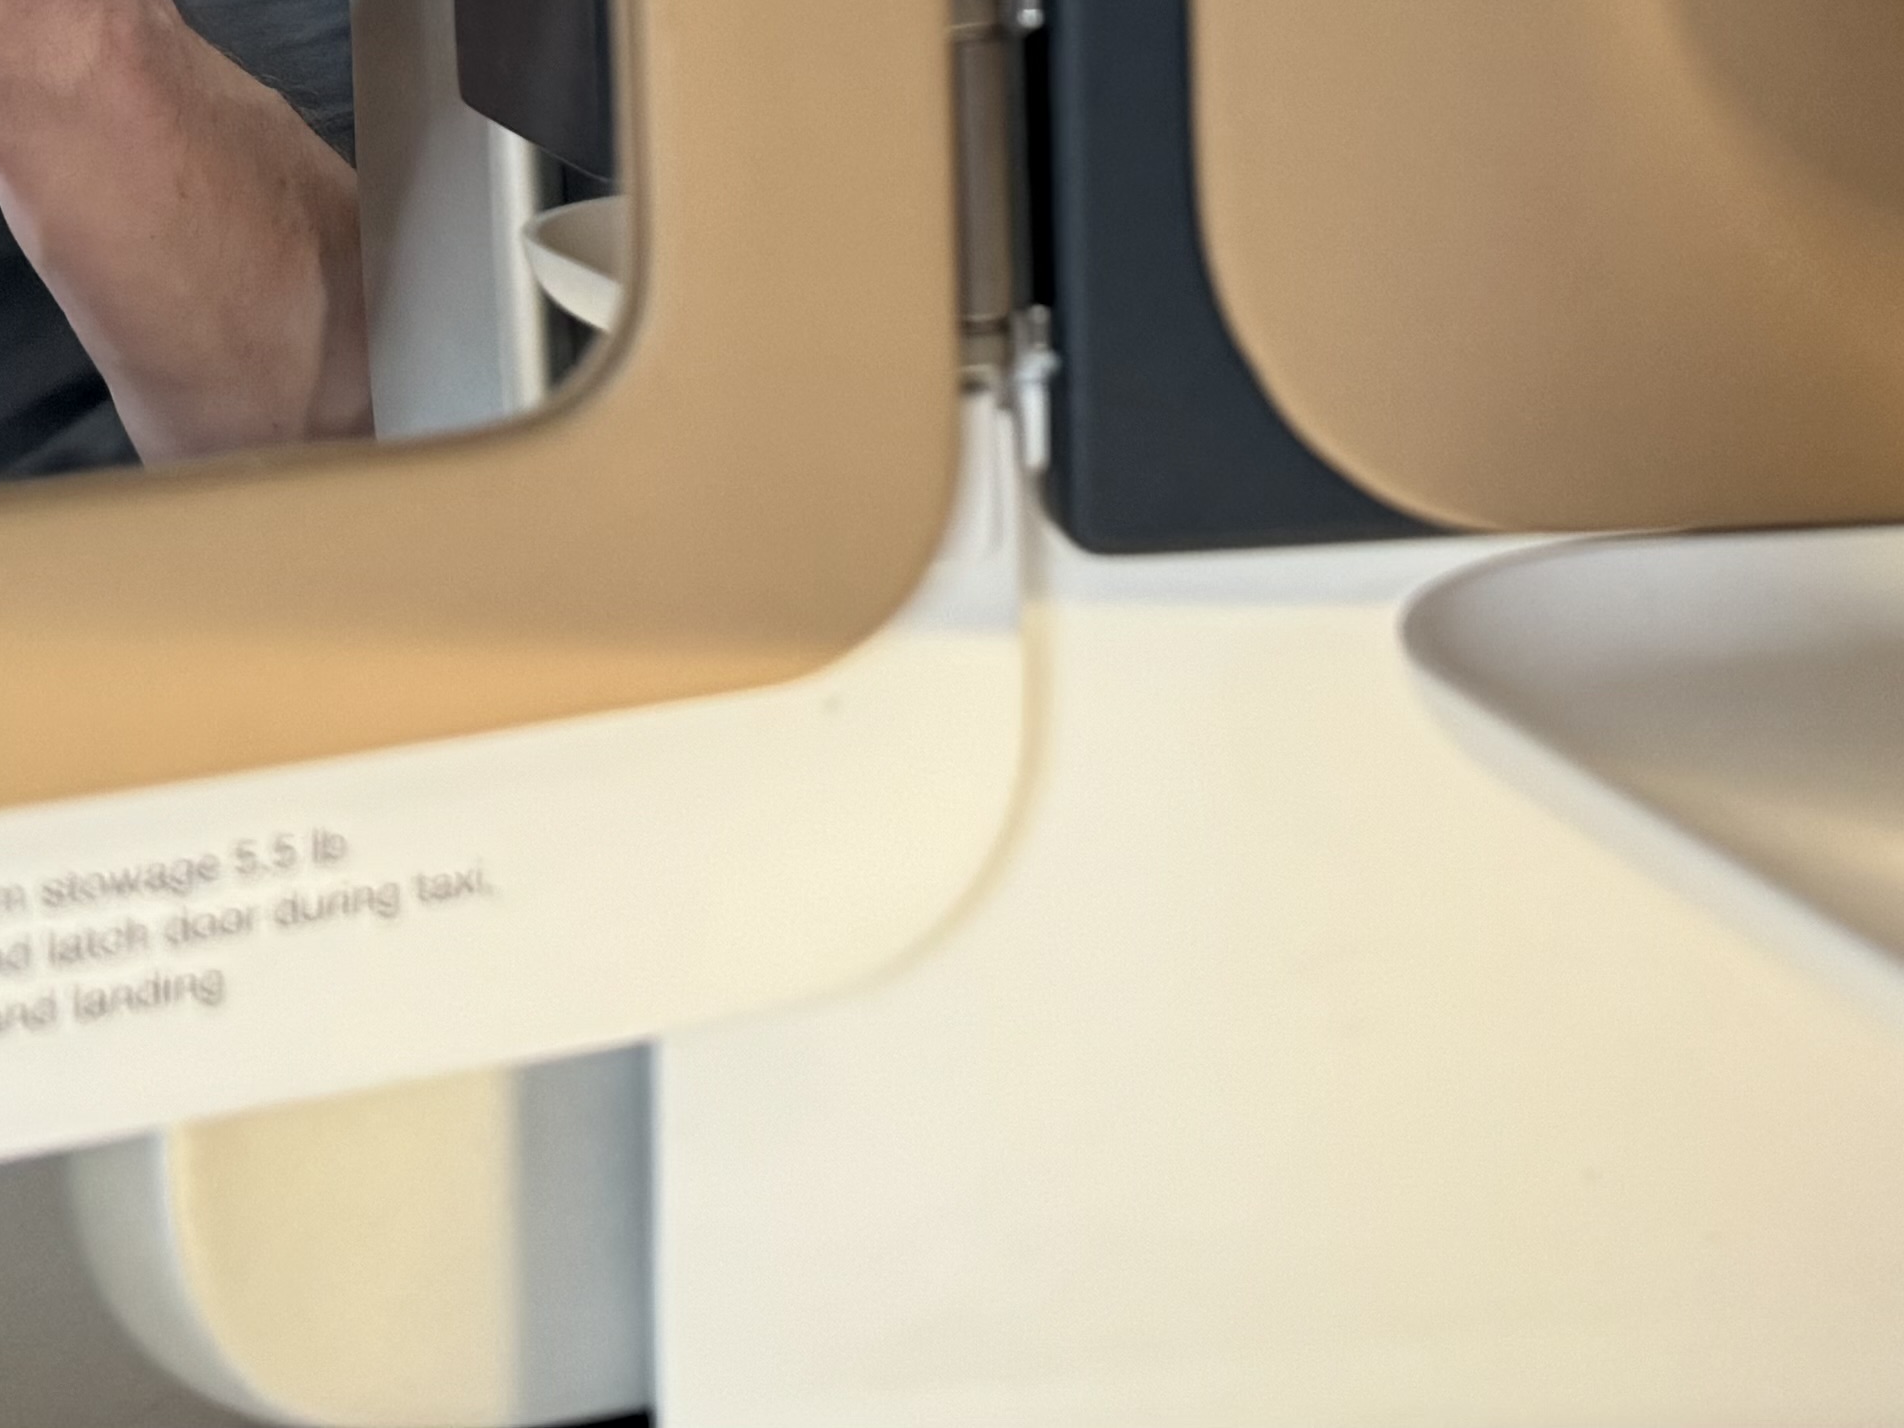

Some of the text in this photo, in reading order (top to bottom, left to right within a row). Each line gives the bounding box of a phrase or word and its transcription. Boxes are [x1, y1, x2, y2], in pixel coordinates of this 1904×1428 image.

[39, 850, 222, 912] stowage
[234, 838, 299, 877] 5.5
[310, 827, 349, 865] lb
[49, 914, 151, 970] latch
[163, 902, 262, 947] door
[274, 874, 403, 930] during
[70, 964, 227, 1026] landing
